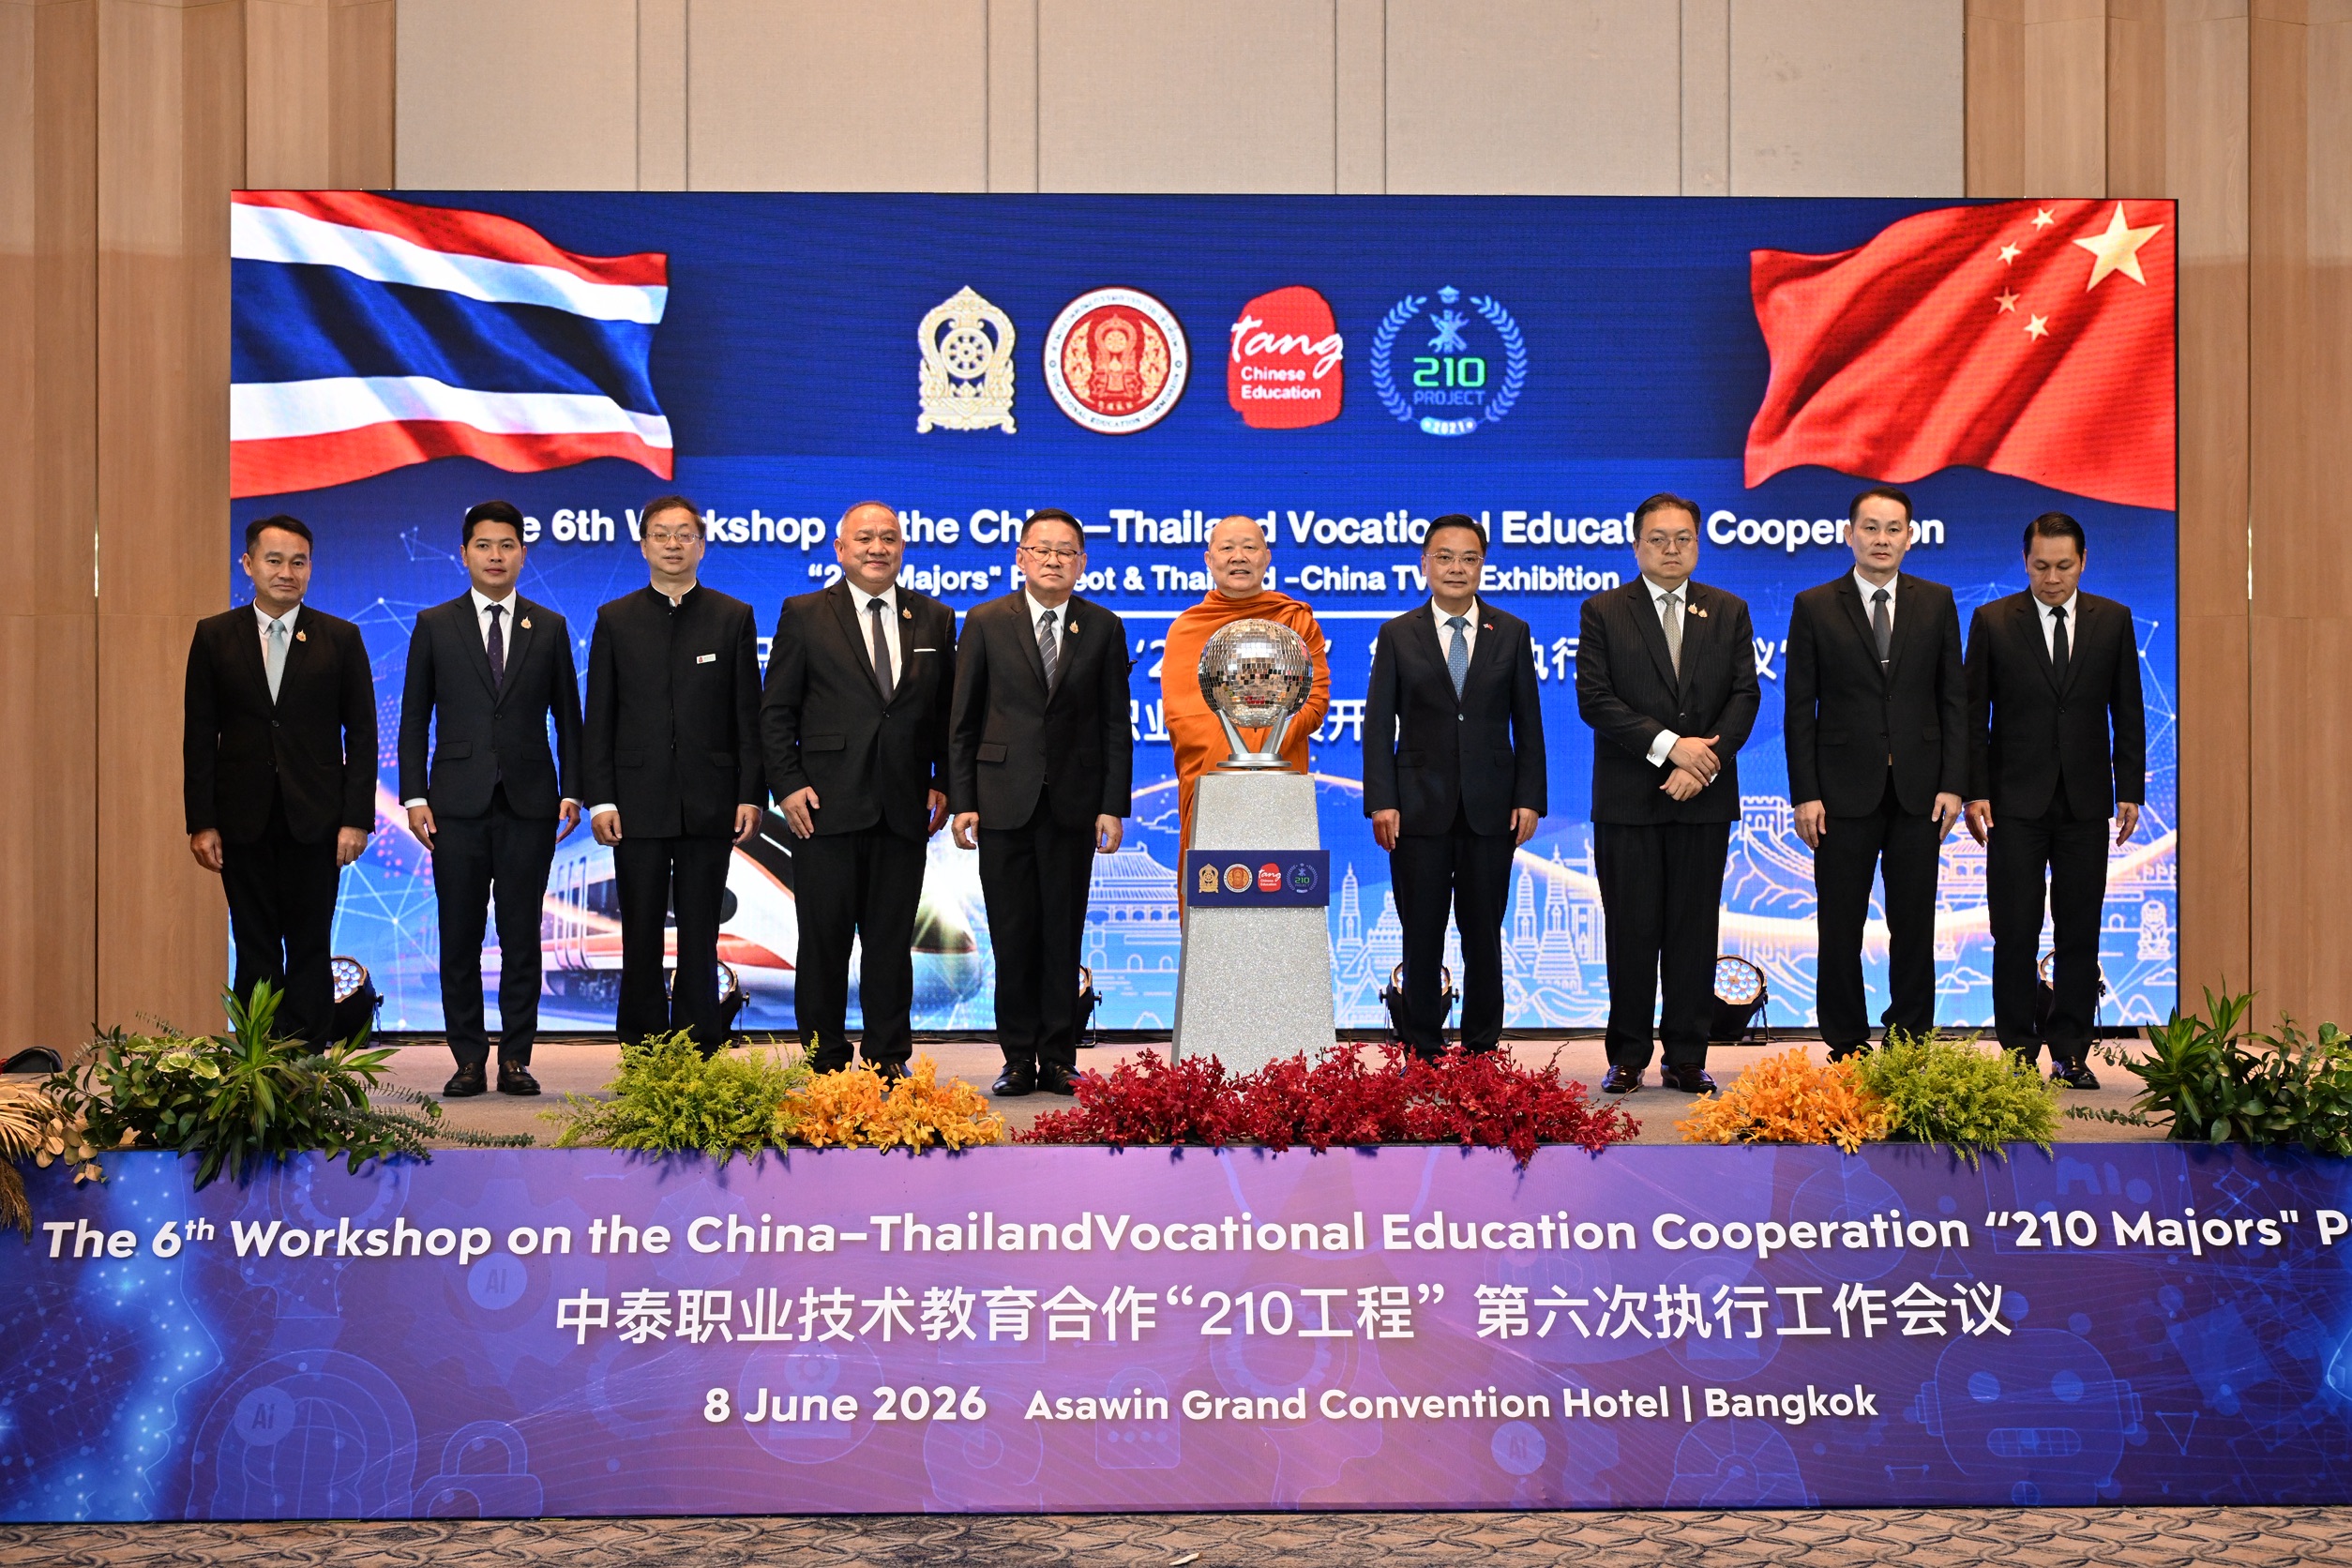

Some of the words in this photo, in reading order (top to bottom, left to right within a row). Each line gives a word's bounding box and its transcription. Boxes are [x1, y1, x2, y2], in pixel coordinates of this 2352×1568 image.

[1231, 315, 1343, 379] tang
[1241, 366, 1306, 381] Chinese
[1413, 357, 1485, 386] 210
[1241, 384, 1321, 400] Education
[1413, 390, 1485, 405] PROJECT
[551, 508, 615, 542] 6th
[1287, 509, 1490, 545] Vocatiol
[1502, 511, 1636, 545] Educat
[1123, 565, 1146, 591] &
[1478, 564, 1620, 591] Exhibition
[42, 1220, 137, 1259] The
[230, 1216, 491, 1265] Workshop
[507, 1226, 571, 1255] on
[588, 1214, 671, 1254] the
[1382, 1210, 1636, 1251] Education
[1651, 1209, 1969, 1259] Cooperation
[1473, 1281, 2013, 1339] 第六次执行工作会议
[703, 1387, 730, 1423] 8
[744, 1388, 858, 1423] June
[872, 1385, 987, 1421] 2026
[1024, 1387, 1168, 1420] Asawin
[1182, 1387, 1306, 1420] Grand
[1319, 1385, 1550, 1420] Convention
[1563, 1385, 1669, 1419] Hotel
[1704, 1383, 1878, 1425] Bangkok
